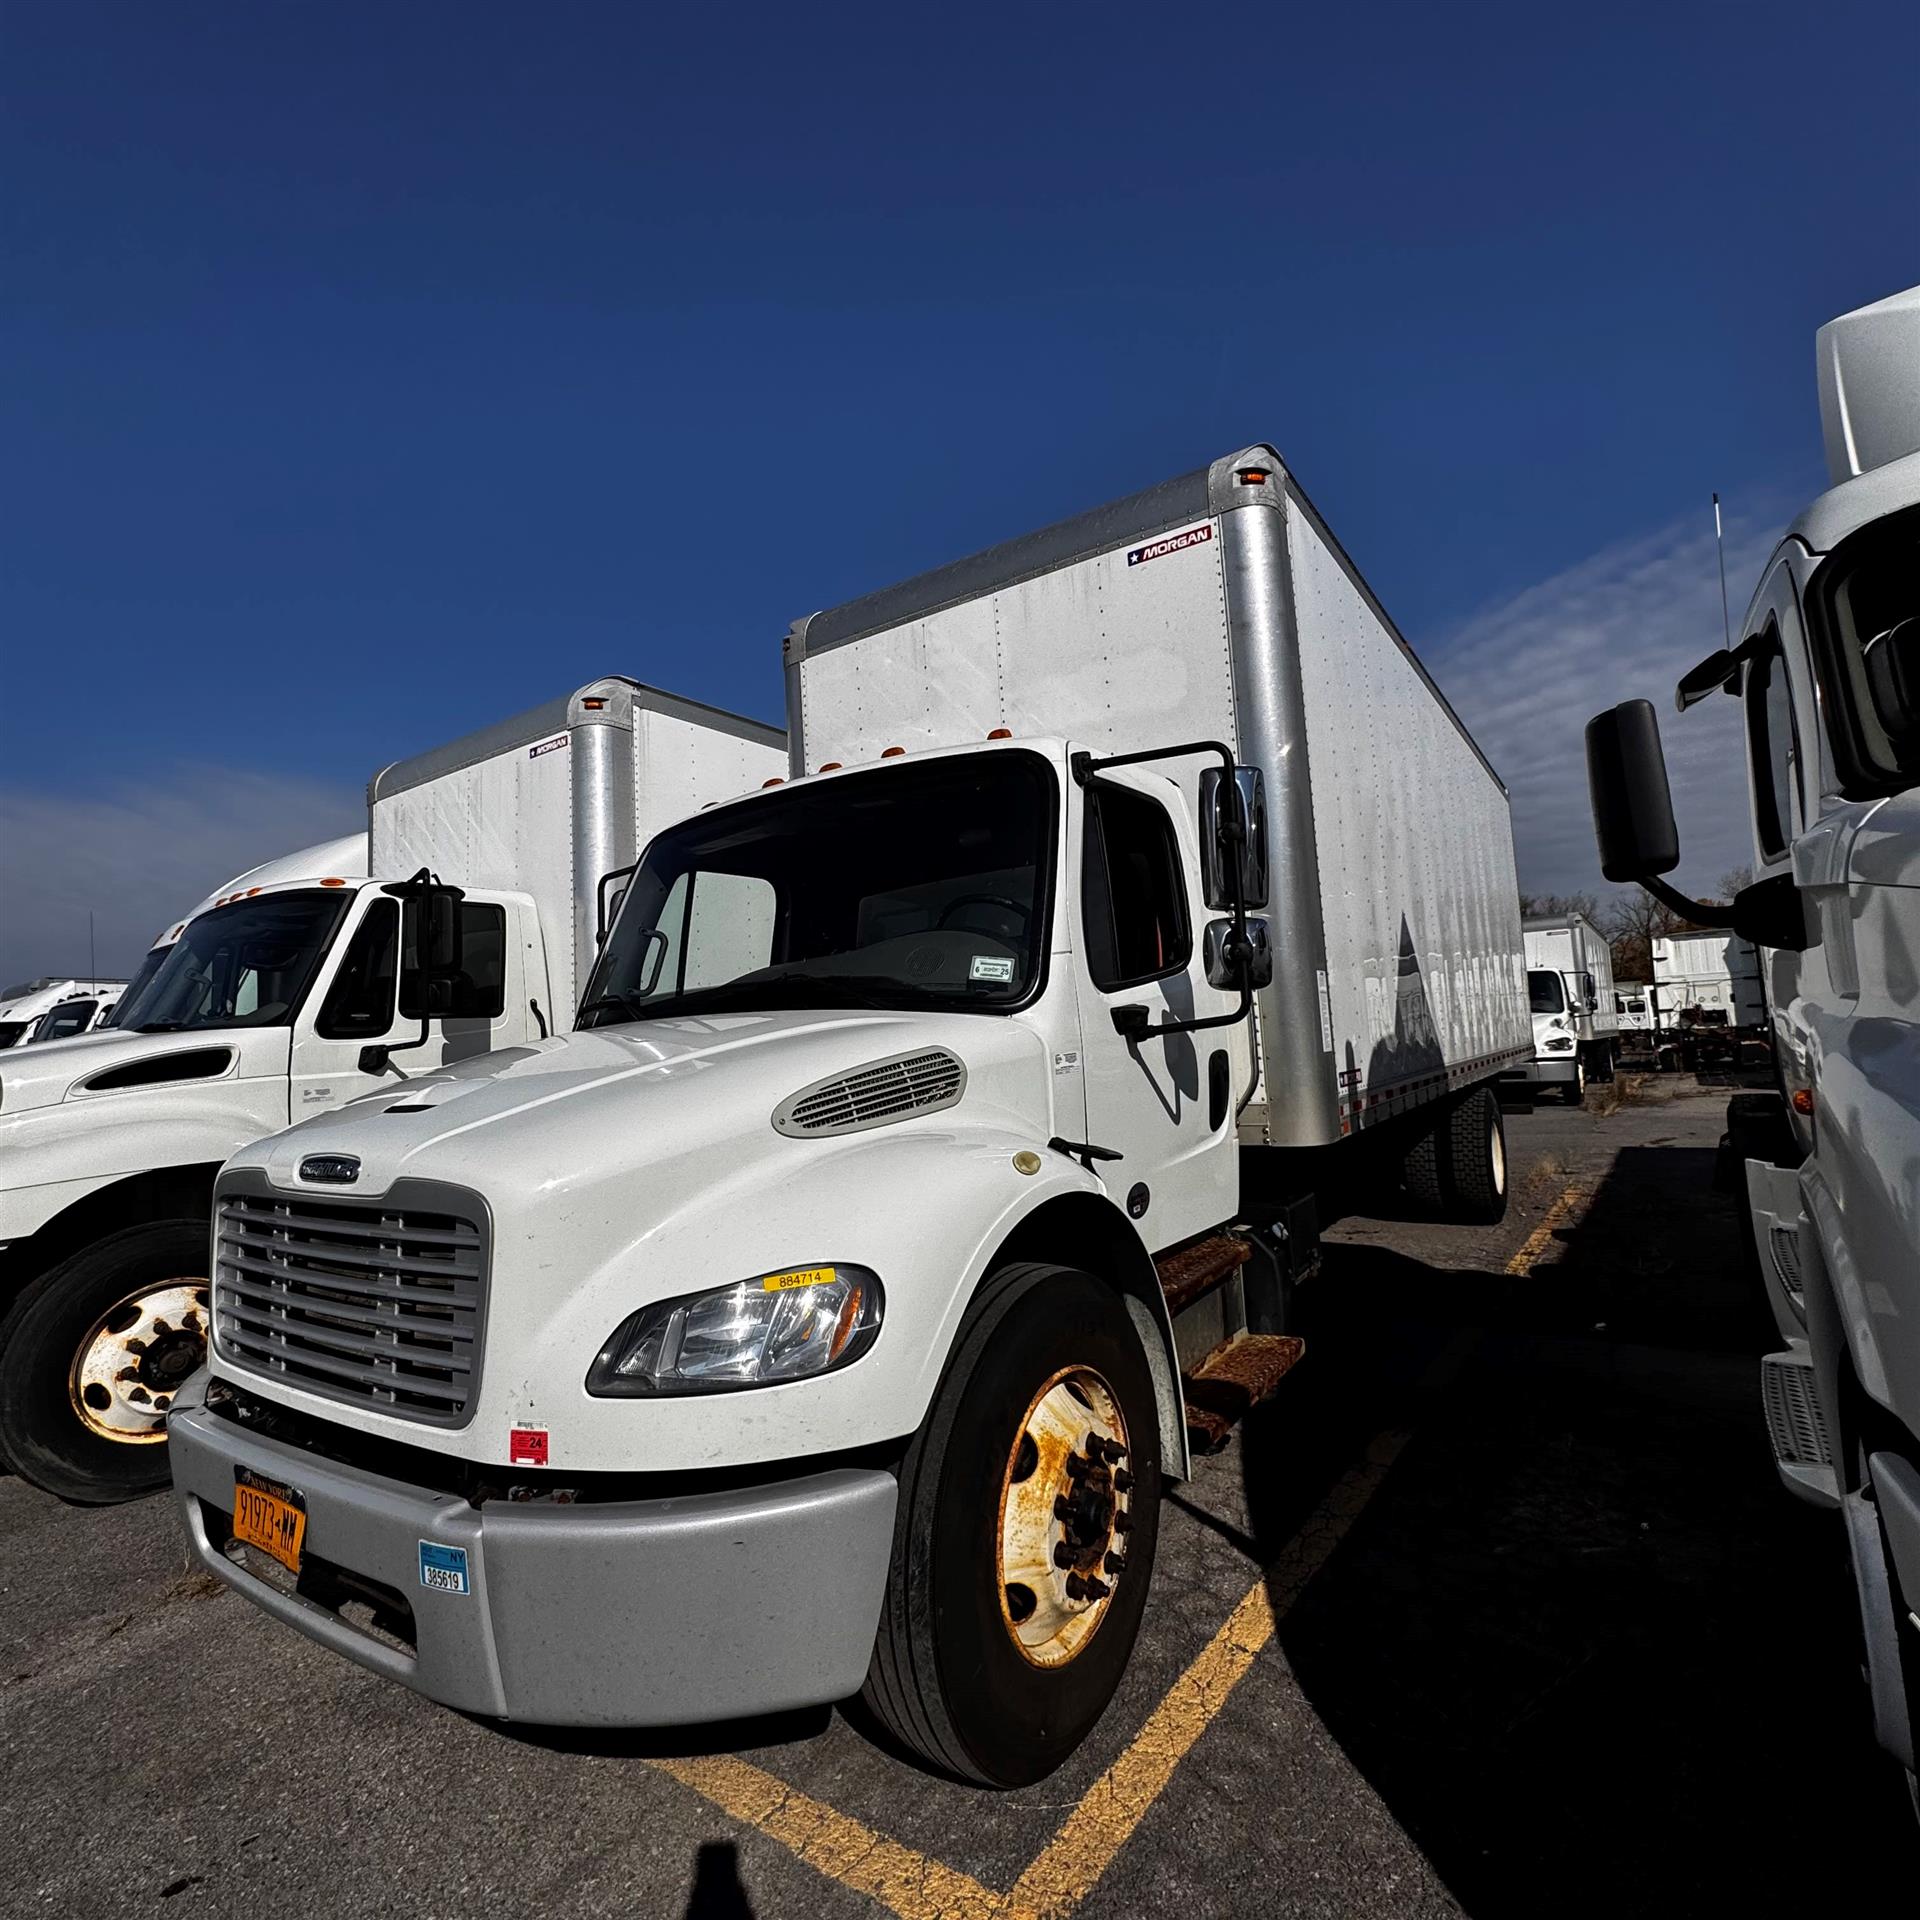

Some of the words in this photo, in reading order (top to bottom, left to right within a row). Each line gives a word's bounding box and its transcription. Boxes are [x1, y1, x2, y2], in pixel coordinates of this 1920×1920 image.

[1142, 528, 1209, 561] MORGAN
[535, 737, 567, 756] MORGAN
[779, 1271, 822, 1288] 884714
[529, 1437, 543, 1450] 24
[450, 1551, 465, 1563] NY
[427, 1567, 460, 1590] 385619
